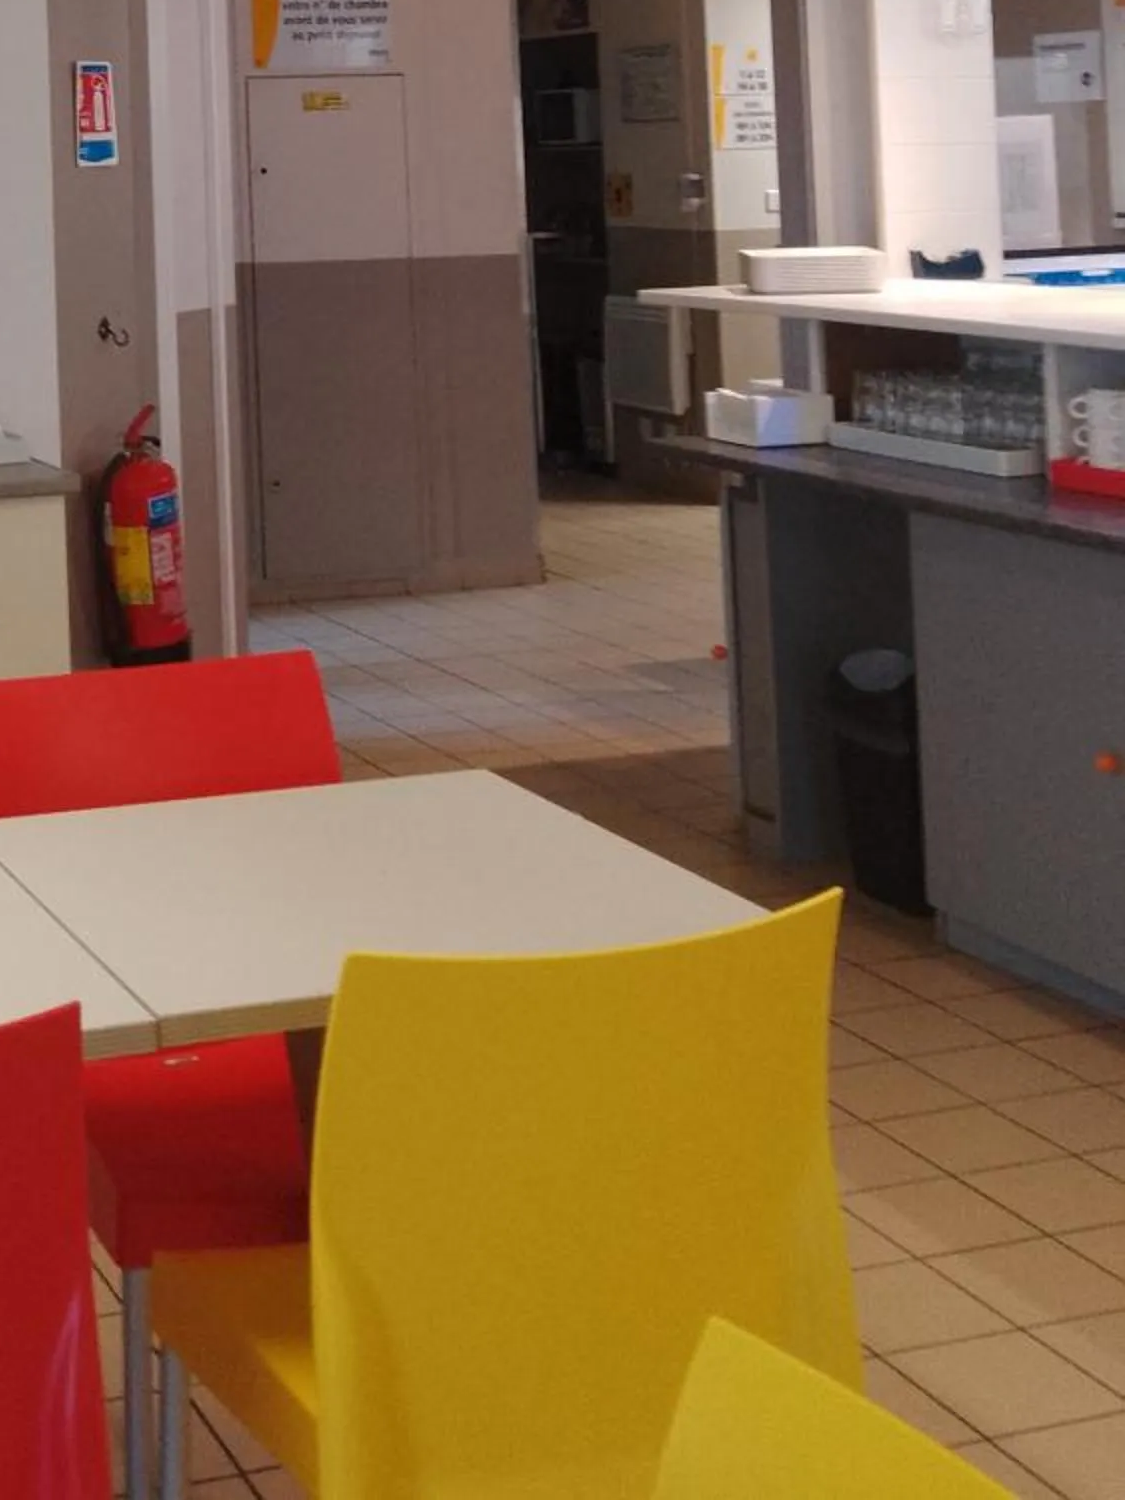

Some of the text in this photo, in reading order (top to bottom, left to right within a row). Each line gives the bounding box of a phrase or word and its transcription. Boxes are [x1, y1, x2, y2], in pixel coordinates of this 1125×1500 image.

[328, 0, 341, 10] de
[344, 0, 388, 10] chambre
[316, 15, 329, 25] de
[332, 16, 357, 26] vous
